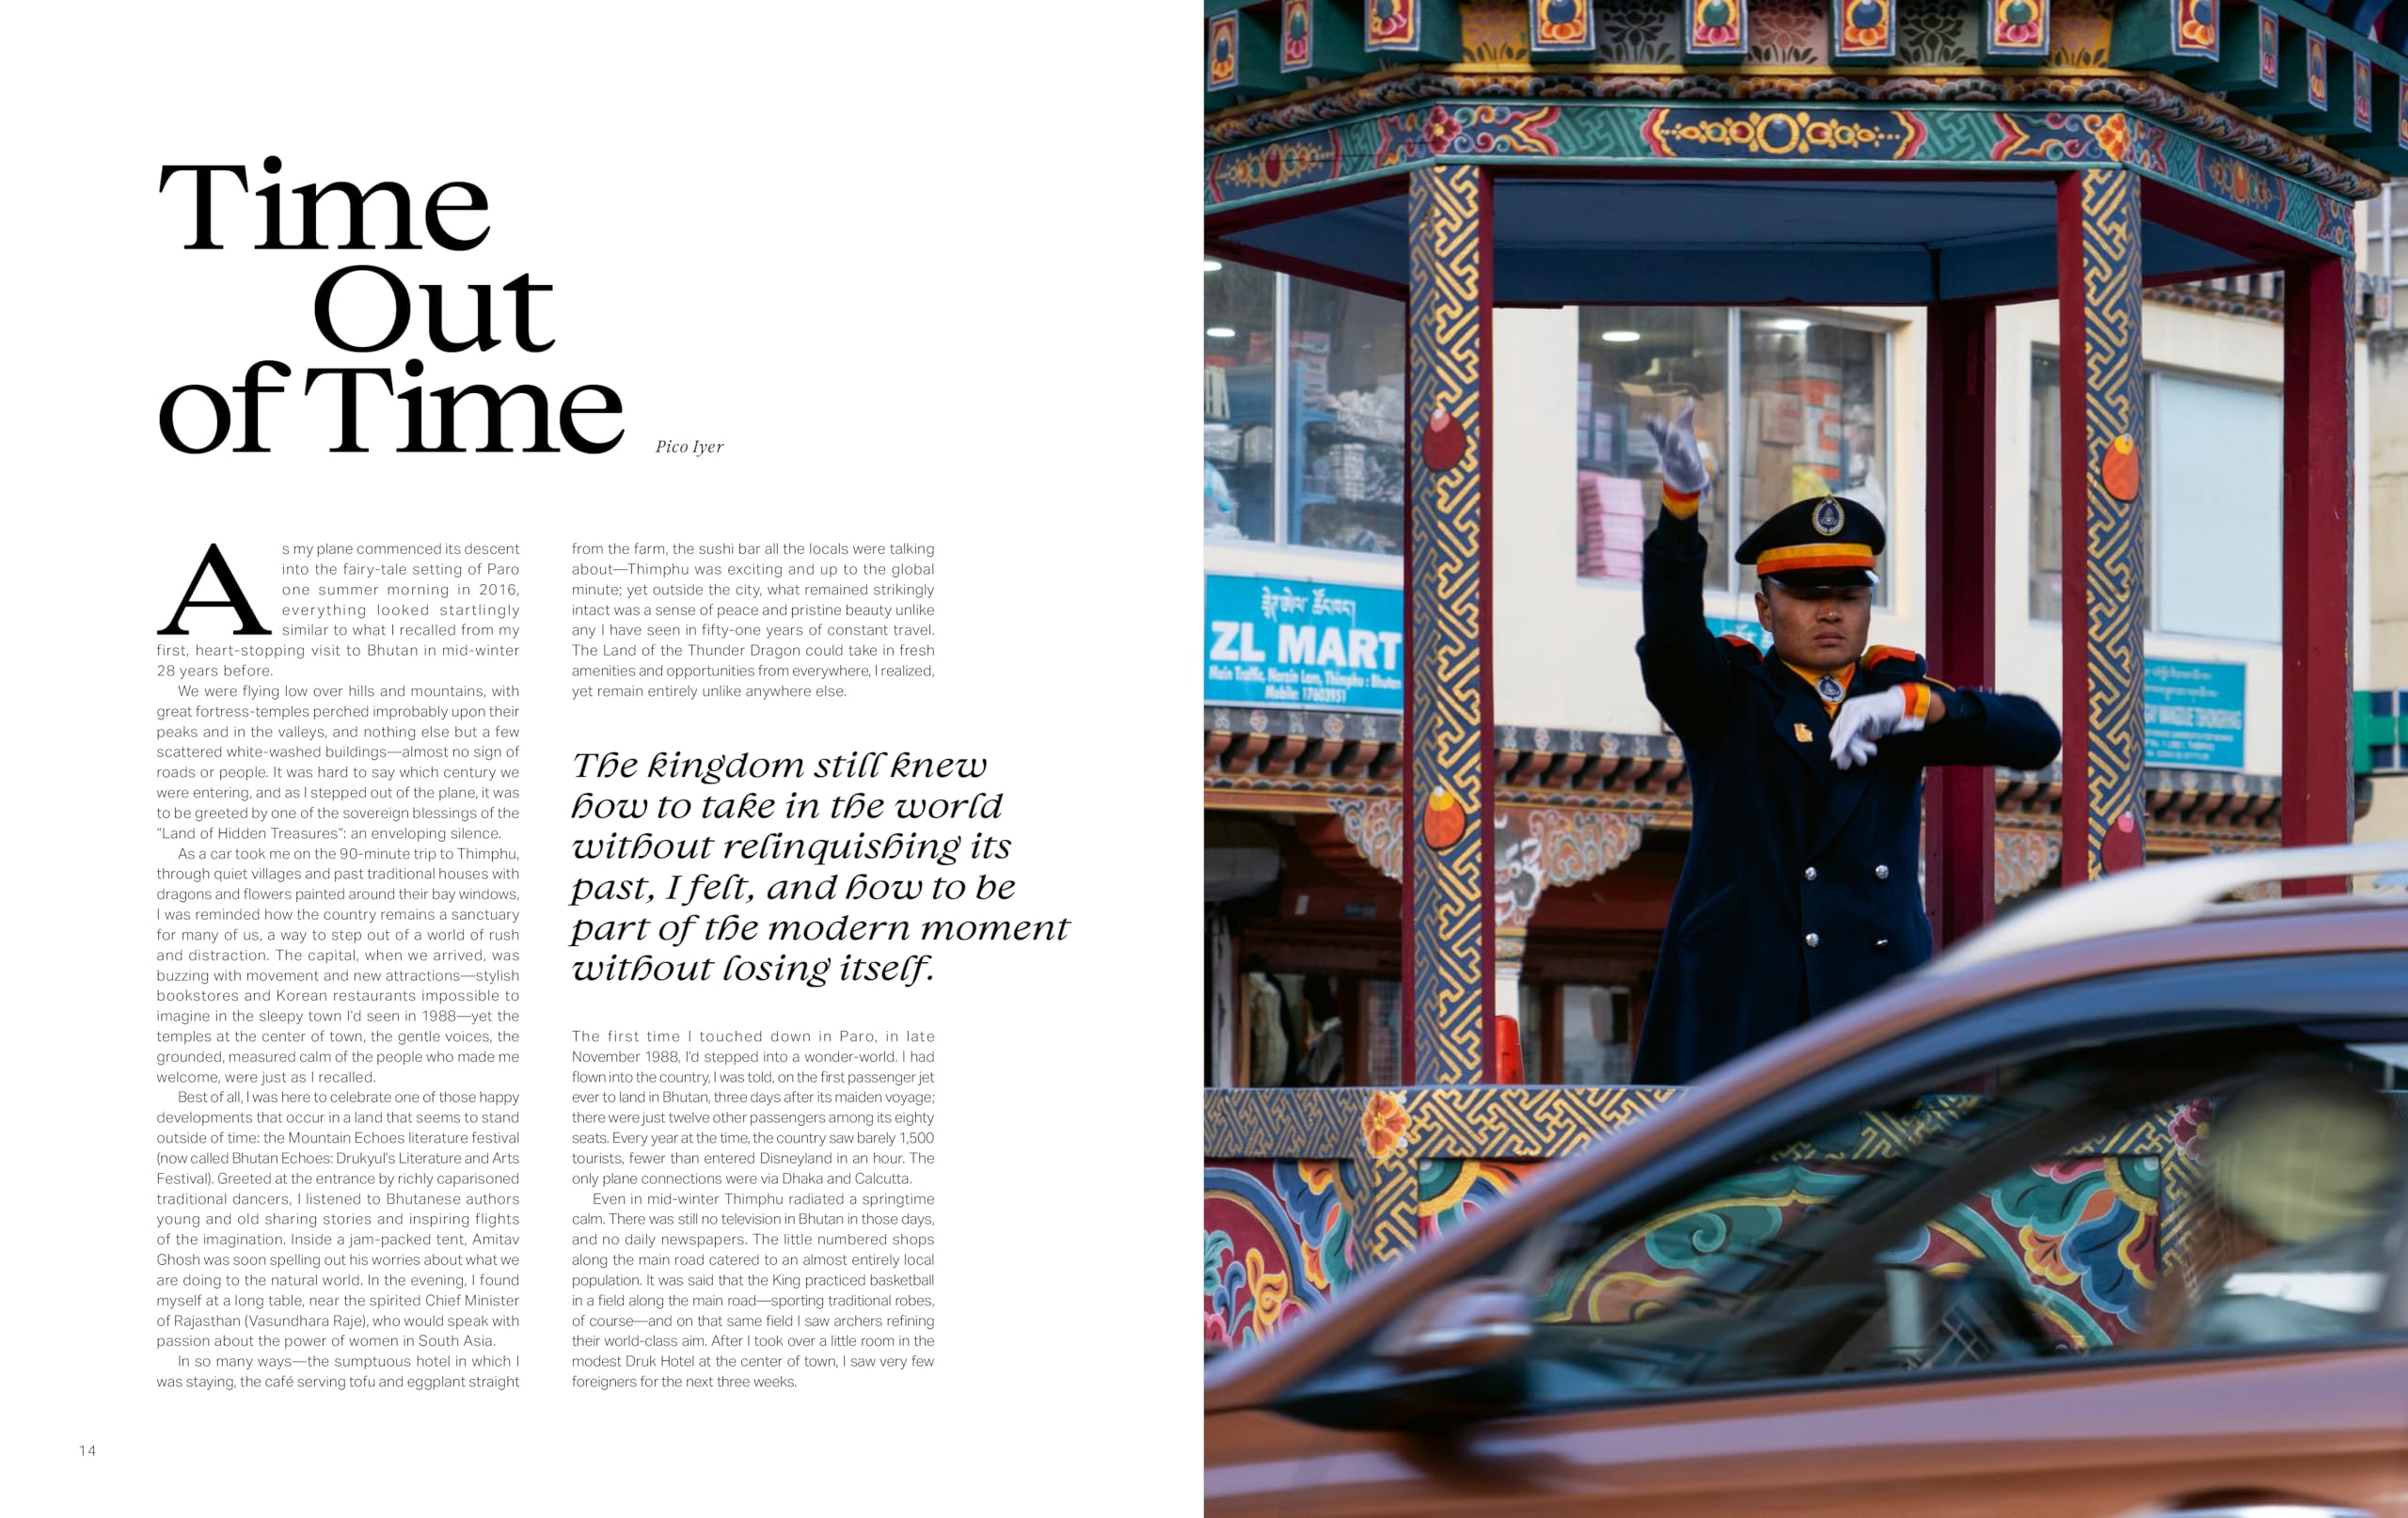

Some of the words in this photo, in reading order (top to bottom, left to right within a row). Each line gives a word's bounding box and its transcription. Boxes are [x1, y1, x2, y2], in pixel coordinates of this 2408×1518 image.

[158, 155, 492, 252] Time
[313, 264, 557, 354] Out
[158, 359, 293, 455] of
[304, 357, 626, 455] Time
[655, 439, 689, 453] Pico
[691, 439, 725, 458] Iyer
[282, 545, 290, 555] s
[293, 545, 314, 558] my
[316, 543, 354, 558] plane
[356, 543, 442, 555] commenced
[445, 543, 462, 555] its
[464, 543, 520, 555] descent
[571, 542, 604, 555] from
[608, 542, 630, 555] the
[634, 542, 669, 556] farm,
[673, 543, 695, 555] the
[699, 543, 735, 555] sushi
[738, 543, 761, 555] bar
[765, 542, 779, 555] all
[783, 543, 805, 555] the
[809, 542, 848, 555] locals
[852, 545, 886, 555] were
[889, 543, 935, 559] talking
[282, 563, 309, 576] into
[315, 562, 338, 576] the
[343, 562, 407, 578] fairy-tale
[412, 563, 462, 578] setting
[467, 562, 483, 576] of
[487, 562, 520, 576] Paro
[156, 543, 273, 636] A
[281, 586, 310, 596] one
[318, 586, 379, 596] summer
[387, 583, 449, 599] morning
[457, 583, 470, 595] in
[479, 583, 519, 597] 2016,
[282, 604, 366, 620] everything
[377, 603, 429, 616] looked
[439, 604, 520, 620] startlingly
[282, 624, 329, 637] similar
[333, 624, 348, 637] to
[352, 624, 387, 637] what
[400, 624, 456, 637] recalled
[461, 623, 494, 636] from
[499, 626, 520, 640] my
[157, 643, 189, 657] first,
[196, 643, 305, 660] heart-stopping
[310, 644, 341, 656] visit
[346, 644, 361, 656] to
[367, 643, 419, 656] Bhutan
[423, 644, 436, 656] in
[442, 643, 520, 656] mid-winter
[1209, 620, 1266, 662] ZL
[1277, 624, 1402, 671] MART
[157, 664, 176, 677] 28
[179, 667, 218, 680] years
[224, 664, 274, 677] before.
[1209, 664, 1233, 681] Main
[571, 686, 594, 701] yet
[597, 685, 643, 698] remain
[647, 685, 698, 701] entirely
[702, 685, 742, 698] unlike
[745, 685, 812, 701] anywhere
[816, 685, 847, 698] else.
[573, 751, 639, 779] The
[646, 751, 805, 785] kingdom
[813, 750, 888, 779] still
[890, 751, 988, 779] knew
[570, 792, 649, 819] how
[657, 796, 692, 819] to
[701, 792, 776, 819] take
[785, 791, 820, 819] in
[831, 792, 885, 819] the
[894, 792, 1005, 819] world
[156, 827, 196, 840] “Land
[199, 827, 214, 840] of
[218, 827, 266, 840] Hidden
[270, 827, 346, 840] Treasures”:
[350, 830, 367, 840] an
[371, 827, 447, 843] enveloping
[451, 827, 501, 840] silence.
[571, 831, 716, 860] without
[723, 831, 962, 866] relinquishing
[971, 831, 1012, 860] its
[567, 877, 655, 907] past,
[664, 874, 682, 900] I
[683, 873, 755, 908] felt,
[767, 874, 839, 901] felt,
[845, 873, 925, 901] how
[932, 877, 967, 900] to
[975, 874, 1016, 901] be
[567, 917, 652, 947] part
[657, 913, 701, 948] of
[705, 913, 759, 941] the
[768, 914, 911, 941] modern
[921, 917, 1073, 941] moment
[571, 953, 716, 982] without
[722, 953, 832, 988] losing
[840, 953, 933, 988] itself.
[571, 1030, 600, 1043] The
[608, 1029, 640, 1043] first
[646, 1030, 680, 1043] time
[699, 1030, 762, 1043] touched
[770, 1030, 811, 1043] down
[818, 1030, 832, 1042] in
[840, 1030, 878, 1044] Paro,
[886, 1030, 898, 1042] in
[907, 1030, 935, 1043] late
[156, 1070, 221, 1084] welcome,
[224, 1073, 258, 1083] were
[260, 1071, 287, 1086] just
[291, 1073, 307, 1083] as
[318, 1070, 376, 1083] recalled.
[156, 1335, 211, 1350] passion
[214, 1335, 254, 1347] about
[258, 1335, 280, 1347] the
[284, 1336, 327, 1350] power
[331, 1334, 346, 1347] of
[348, 1336, 399, 1347] women
[403, 1335, 415, 1347] in
[419, 1334, 459, 1347] South
[463, 1334, 497, 1347] Asia.
[156, 1378, 183, 1388] was
[185, 1375, 237, 1391] staying,
[240, 1375, 261, 1388] the
[264, 1375, 294, 1388] café
[297, 1378, 346, 1391] serving
[349, 1375, 375, 1388] tofu
[378, 1375, 404, 1388] and
[406, 1375, 467, 1391] eggplant
[468, 1375, 520, 1391] straight
[572, 1375, 638, 1391] foreigners
[640, 1375, 659, 1388] for
[661, 1375, 683, 1388] the
[686, 1376, 714, 1388] next
[717, 1375, 751, 1388] three
[752, 1375, 797, 1388] weeks.
[79, 1445, 96, 1457] 14
